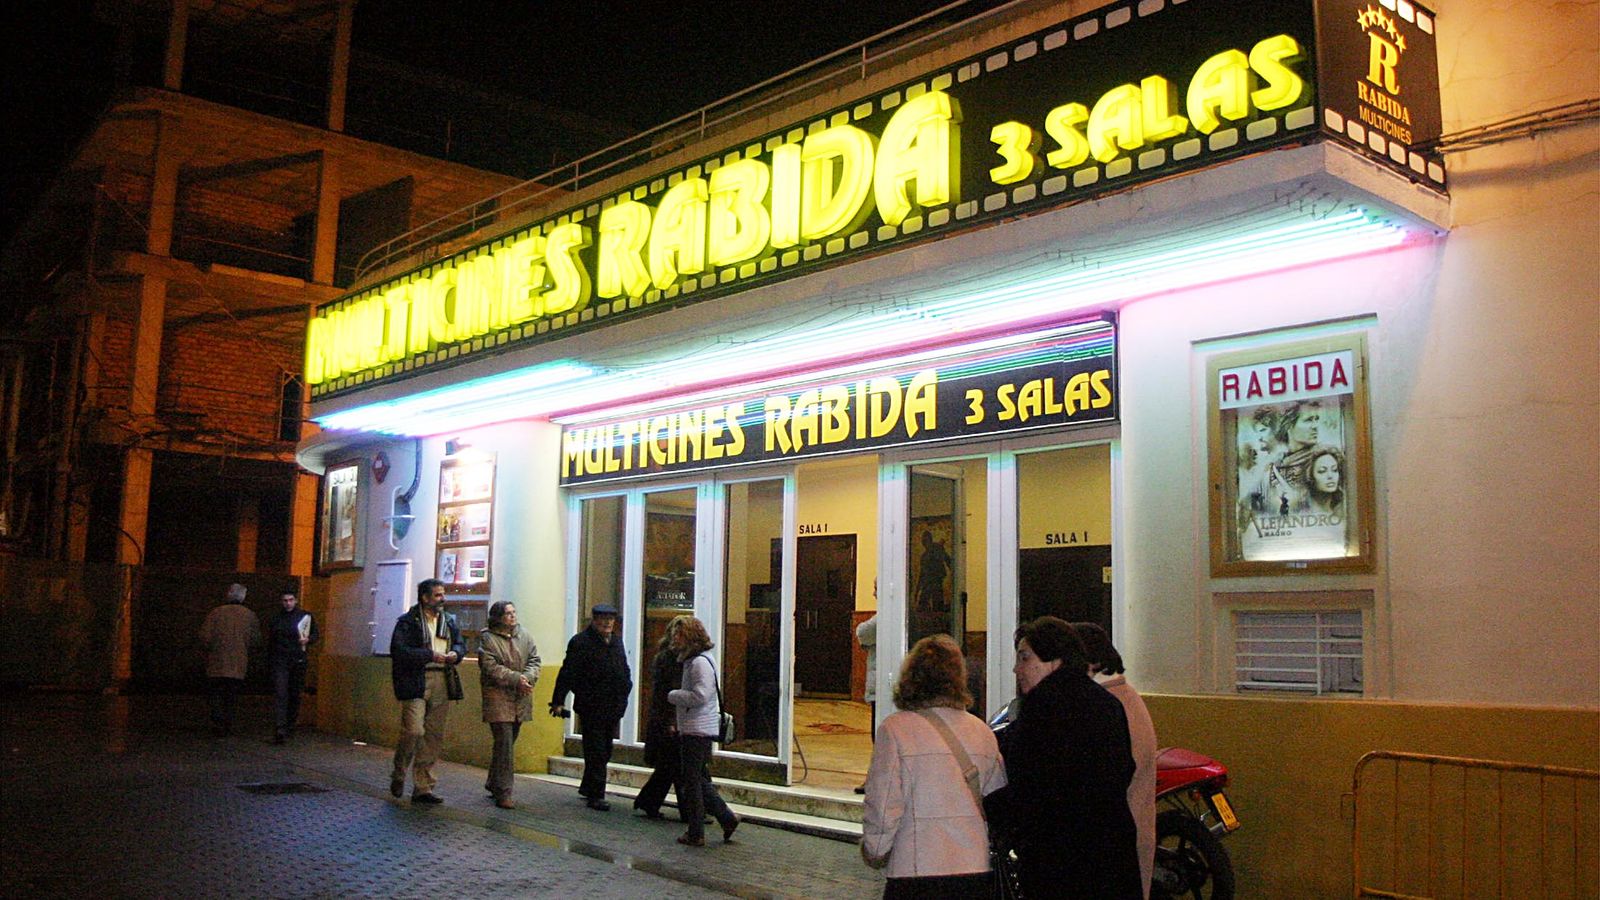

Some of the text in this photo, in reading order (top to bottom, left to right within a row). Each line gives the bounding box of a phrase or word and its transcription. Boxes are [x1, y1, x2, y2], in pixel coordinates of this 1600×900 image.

[1366, 31, 1400, 96] R
[1357, 80, 1412, 126] RABIDA
[1360, 104, 1412, 146] MULTICINES
[306, 34, 1305, 384] MULTICINES RABIDA 3 SALAS
[1222, 358, 1349, 402] RABIDA
[561, 369, 1112, 478] MULTICINES RABIDA 3 SALAS
[799, 523, 822, 534] SALA
[1045, 532, 1077, 545] SALA
[1243, 510, 1342, 538] ALEJANDRO
[1264, 529, 1292, 538] MAGNO
